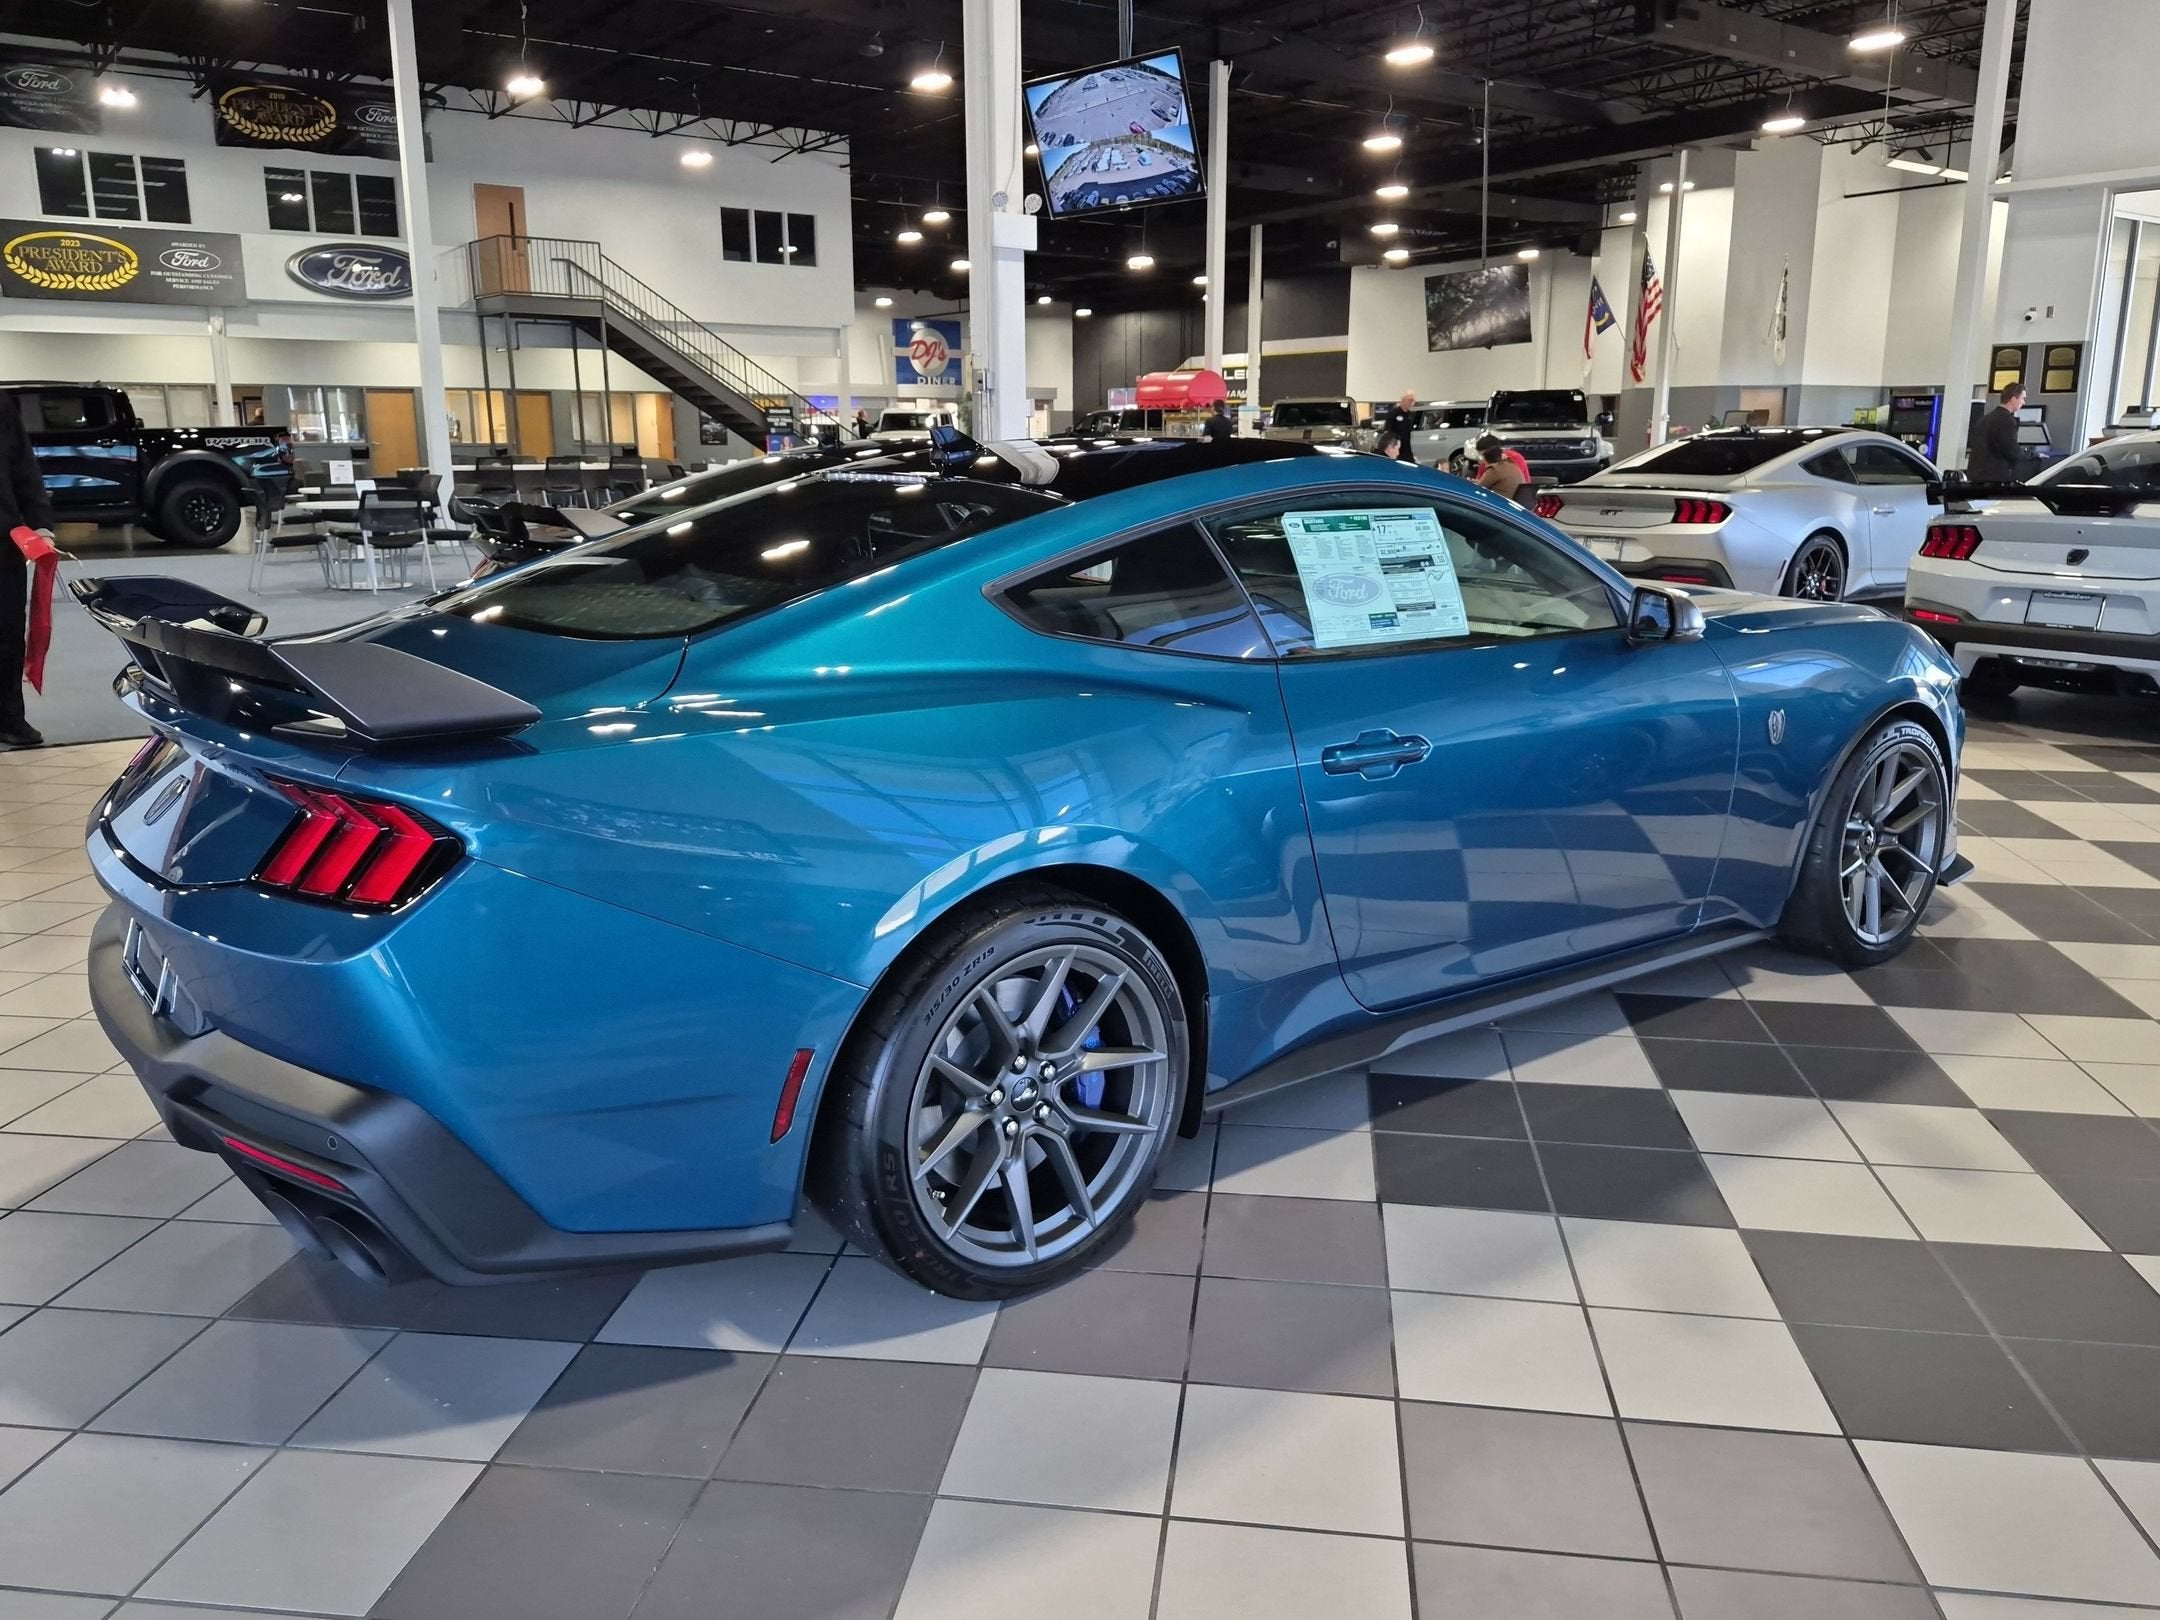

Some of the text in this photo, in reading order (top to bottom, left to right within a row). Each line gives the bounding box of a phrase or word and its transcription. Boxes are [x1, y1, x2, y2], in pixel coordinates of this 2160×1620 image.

[18, 71, 60, 90] Ford
[60, 239, 81, 247] 2023
[18, 245, 128, 264] PRESIDENT'S
[171, 251, 210, 267] Ford
[45, 259, 103, 273] AWARD
[327, 254, 402, 288] Ford
[173, 283, 214, 291] PERFORMANCE
[909, 340, 948, 369] DJ's
[917, 376, 956, 385] DINER
[205, 437, 275, 449] RAPTOR
[1377, 525, 1386, 534] 17
[1327, 578, 1369, 601] Ford
[1901, 727, 1933, 745] TROFEO
[923, 946, 995, 1026] 315/30 ZR19
